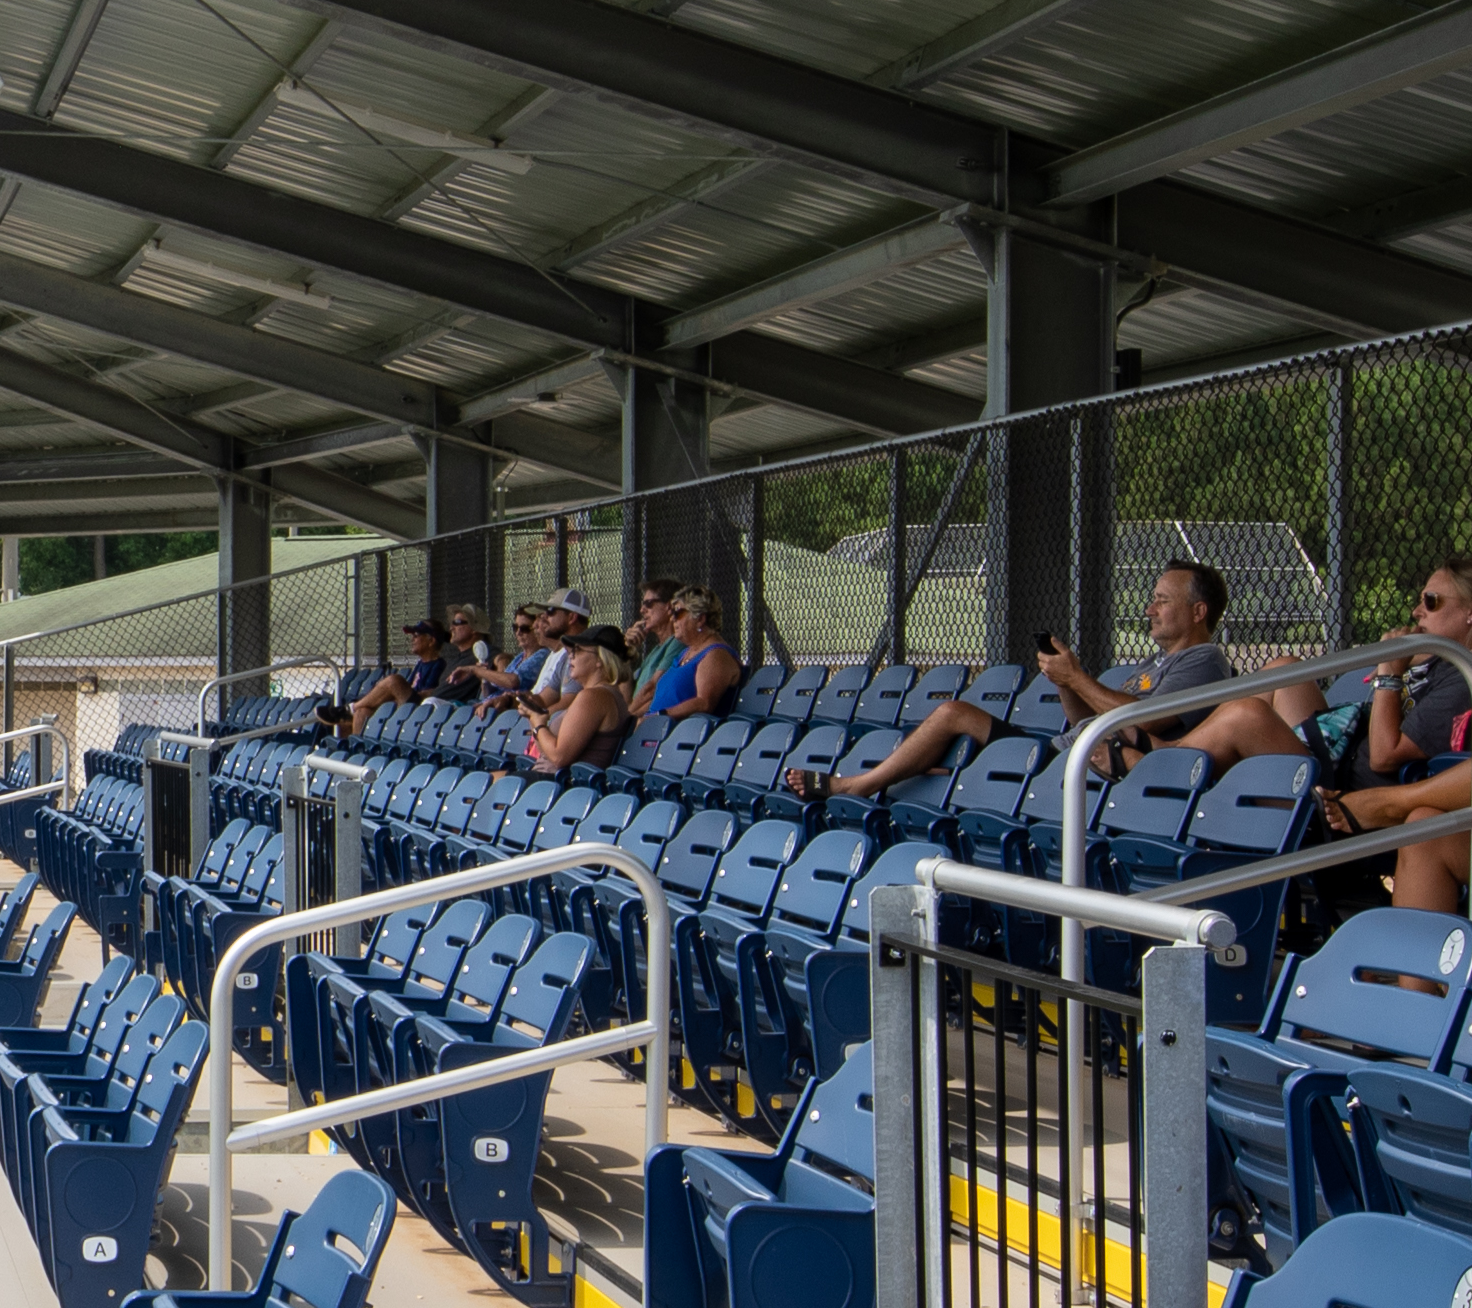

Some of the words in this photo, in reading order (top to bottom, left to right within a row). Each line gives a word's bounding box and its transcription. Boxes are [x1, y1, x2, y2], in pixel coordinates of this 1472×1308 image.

[1225, 947, 1237, 962] D
[1449, 943, 1456, 961] 1
[243, 975, 252, 986] B
[486, 1142, 498, 1157] B
[93, 1241, 107, 1257] A
